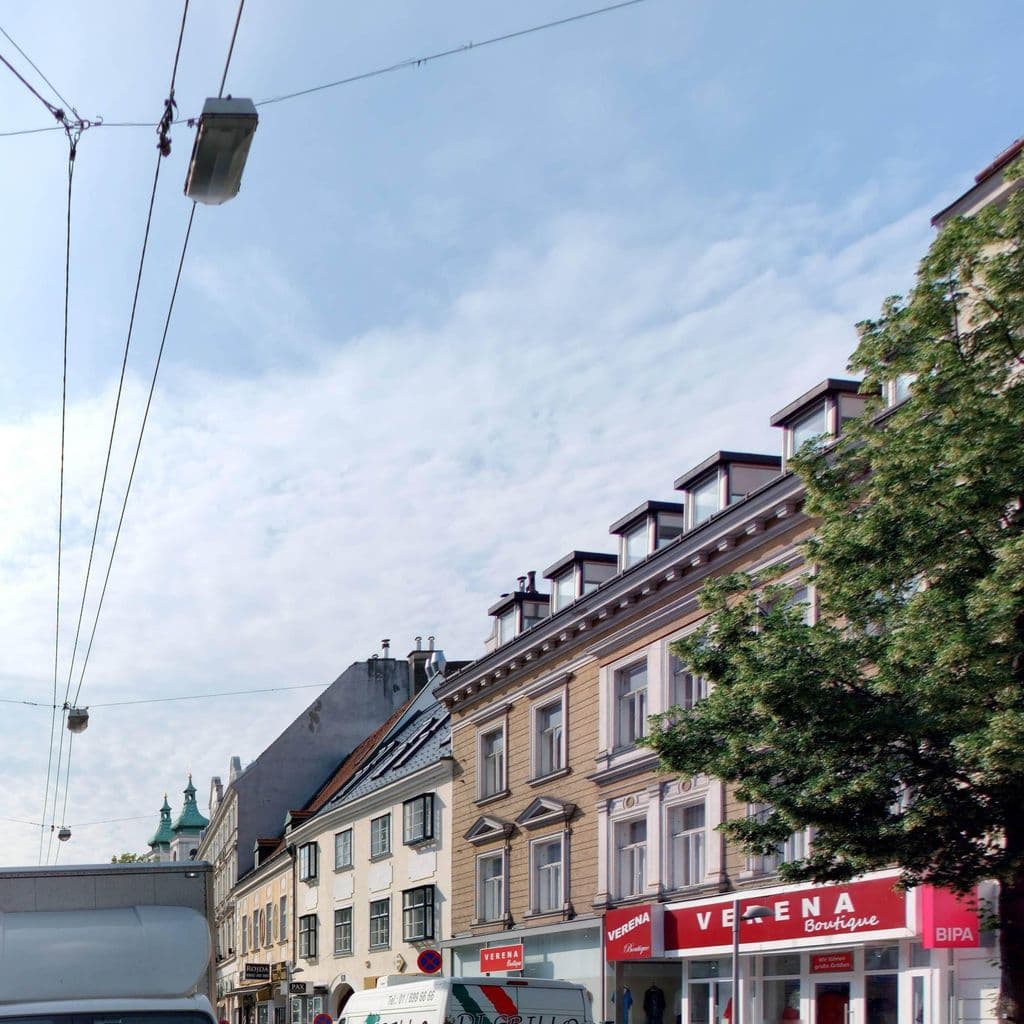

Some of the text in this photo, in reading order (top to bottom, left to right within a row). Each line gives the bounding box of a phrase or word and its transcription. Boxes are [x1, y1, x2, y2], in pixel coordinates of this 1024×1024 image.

[607, 911, 651, 941] VERENA
[804, 914, 879, 932] Boutique
[936, 927, 974, 942] BIPA
[484, 950, 519, 961] VERENA
[291, 983, 305, 991] PAX
